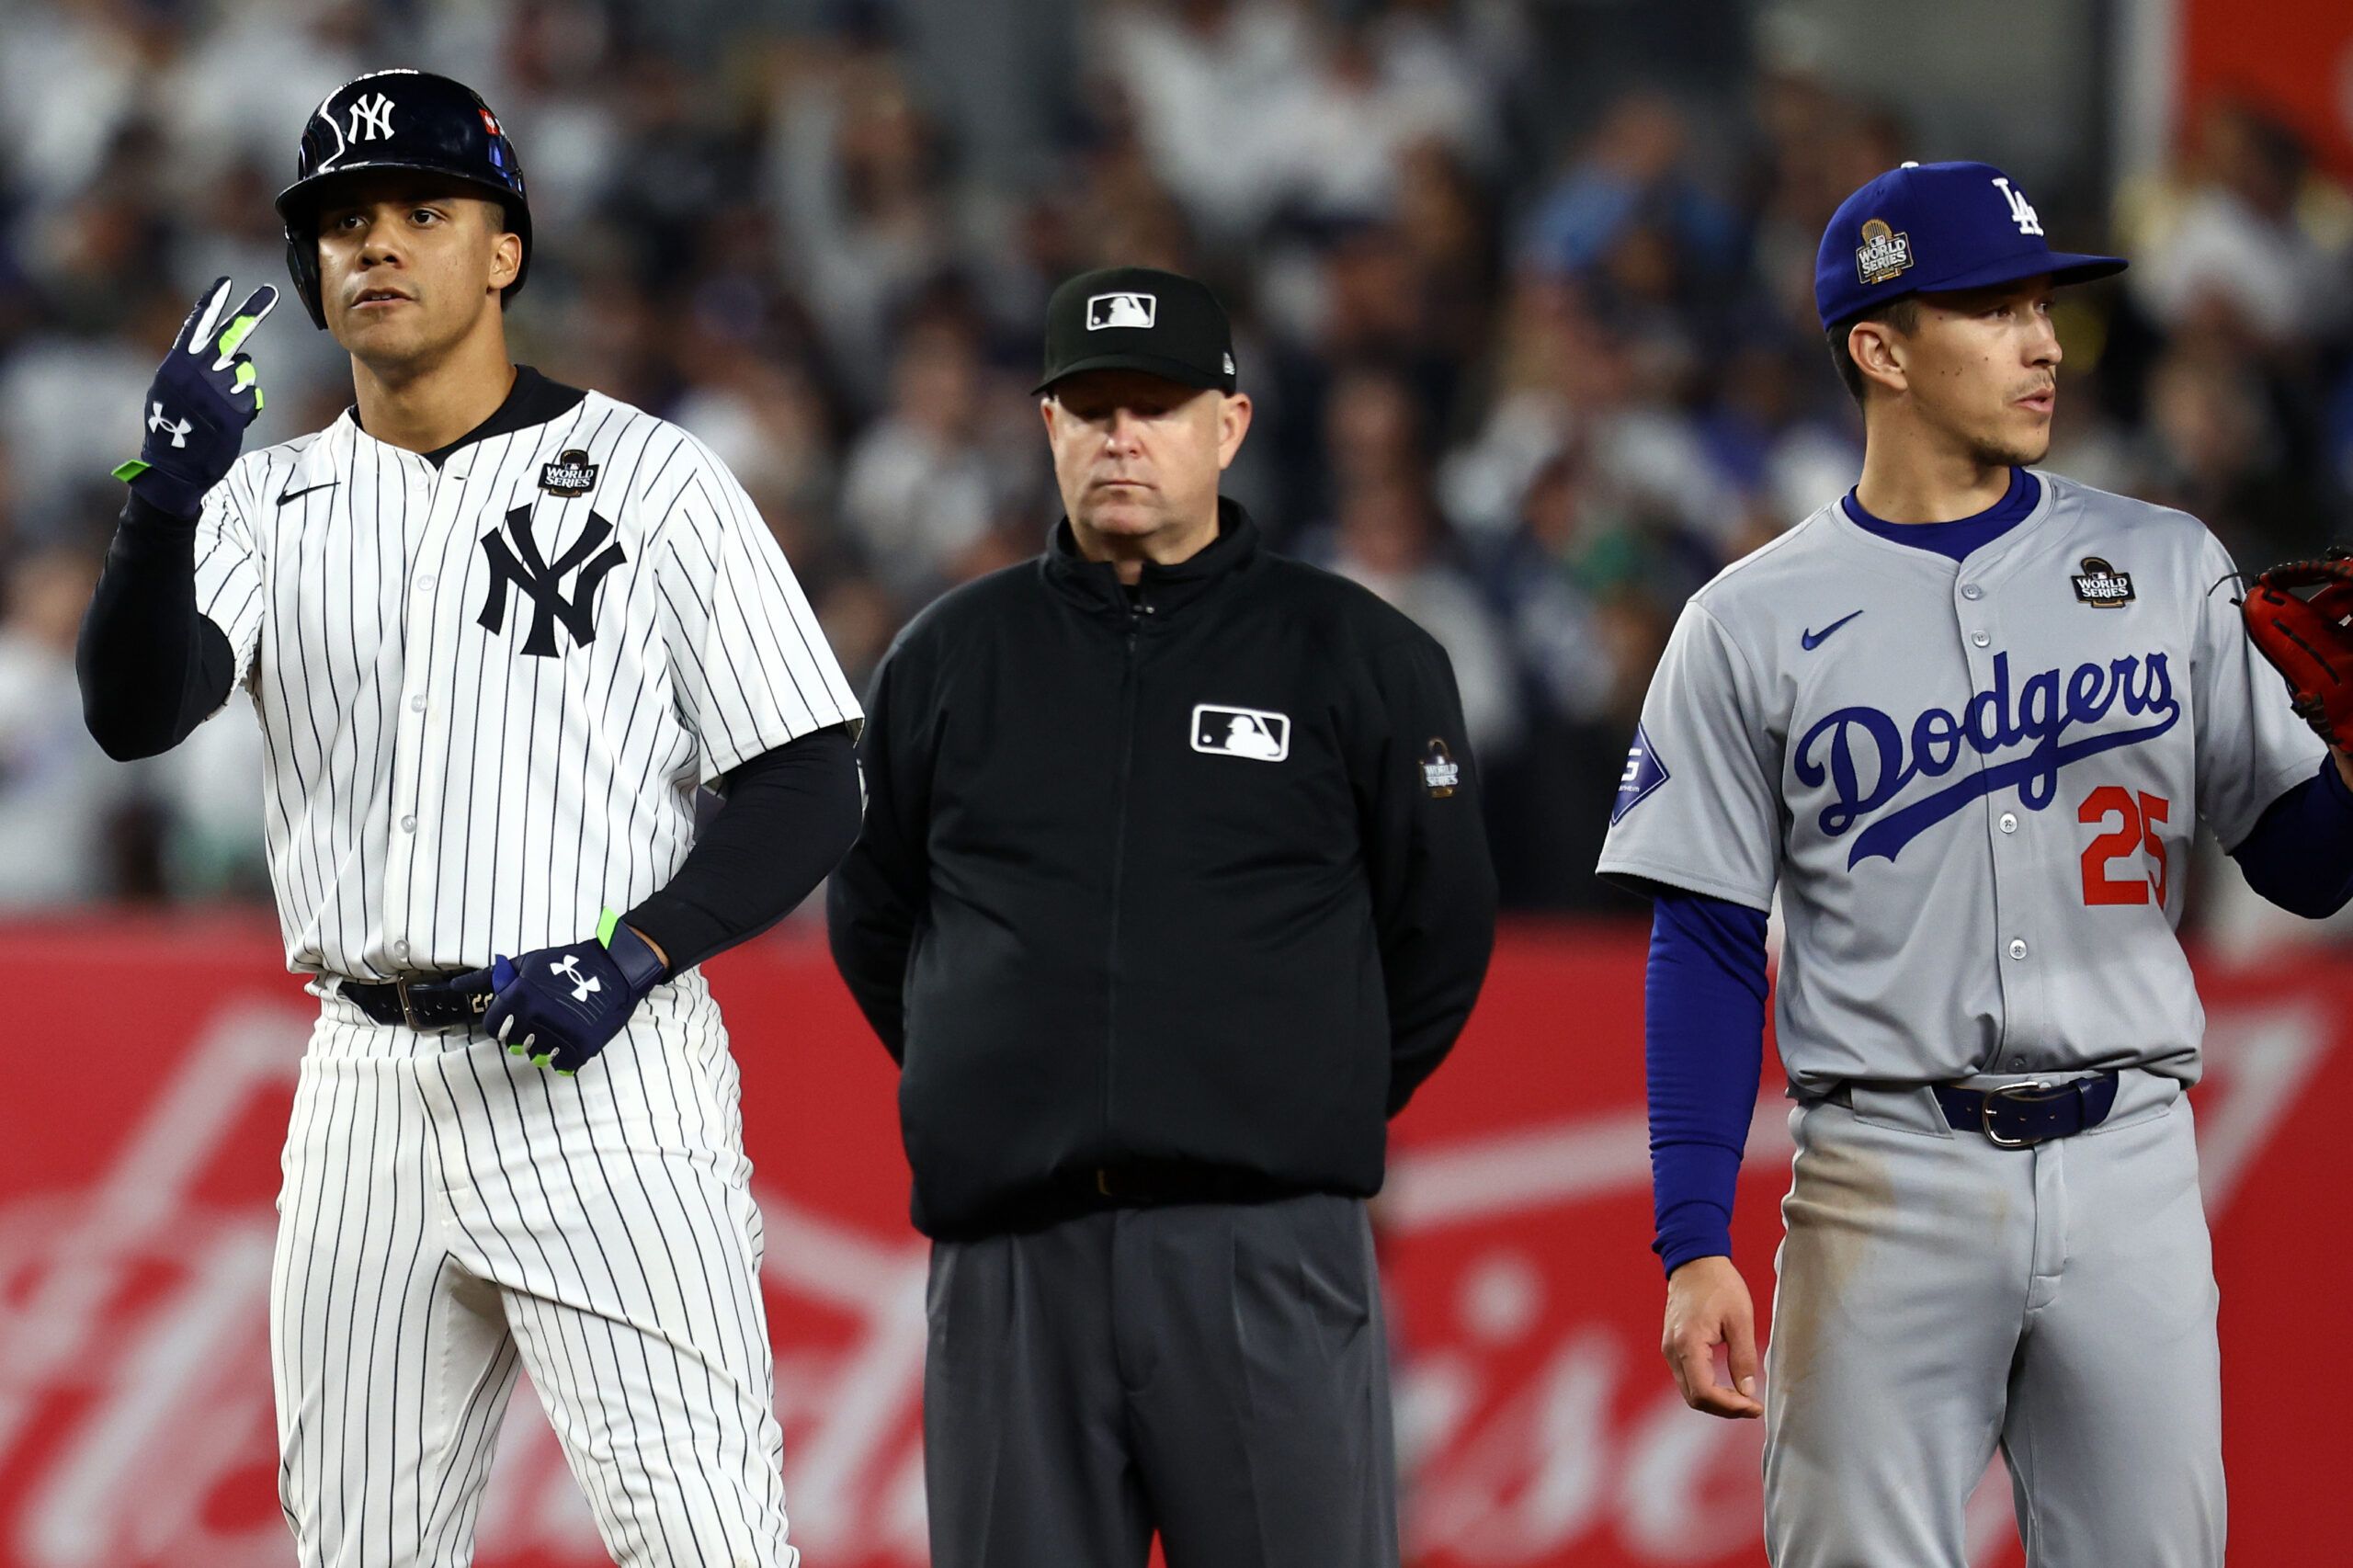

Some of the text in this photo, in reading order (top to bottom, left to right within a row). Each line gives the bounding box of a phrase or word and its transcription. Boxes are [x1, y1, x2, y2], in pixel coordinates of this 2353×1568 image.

[347, 93, 395, 144] NY
[1992, 177, 2044, 237] LA
[1859, 240, 1906, 264] WORLD
[1862, 251, 1907, 275] SERIES
[544, 476, 591, 488] SERIES
[546, 466, 594, 479] WORLD
[476, 503, 628, 658] NY
[2076, 577, 2128, 589] WORLD
[2081, 586, 2129, 598] SERIES
[1794, 651, 2180, 836] Dodgers
[2077, 786, 2169, 909] 25
